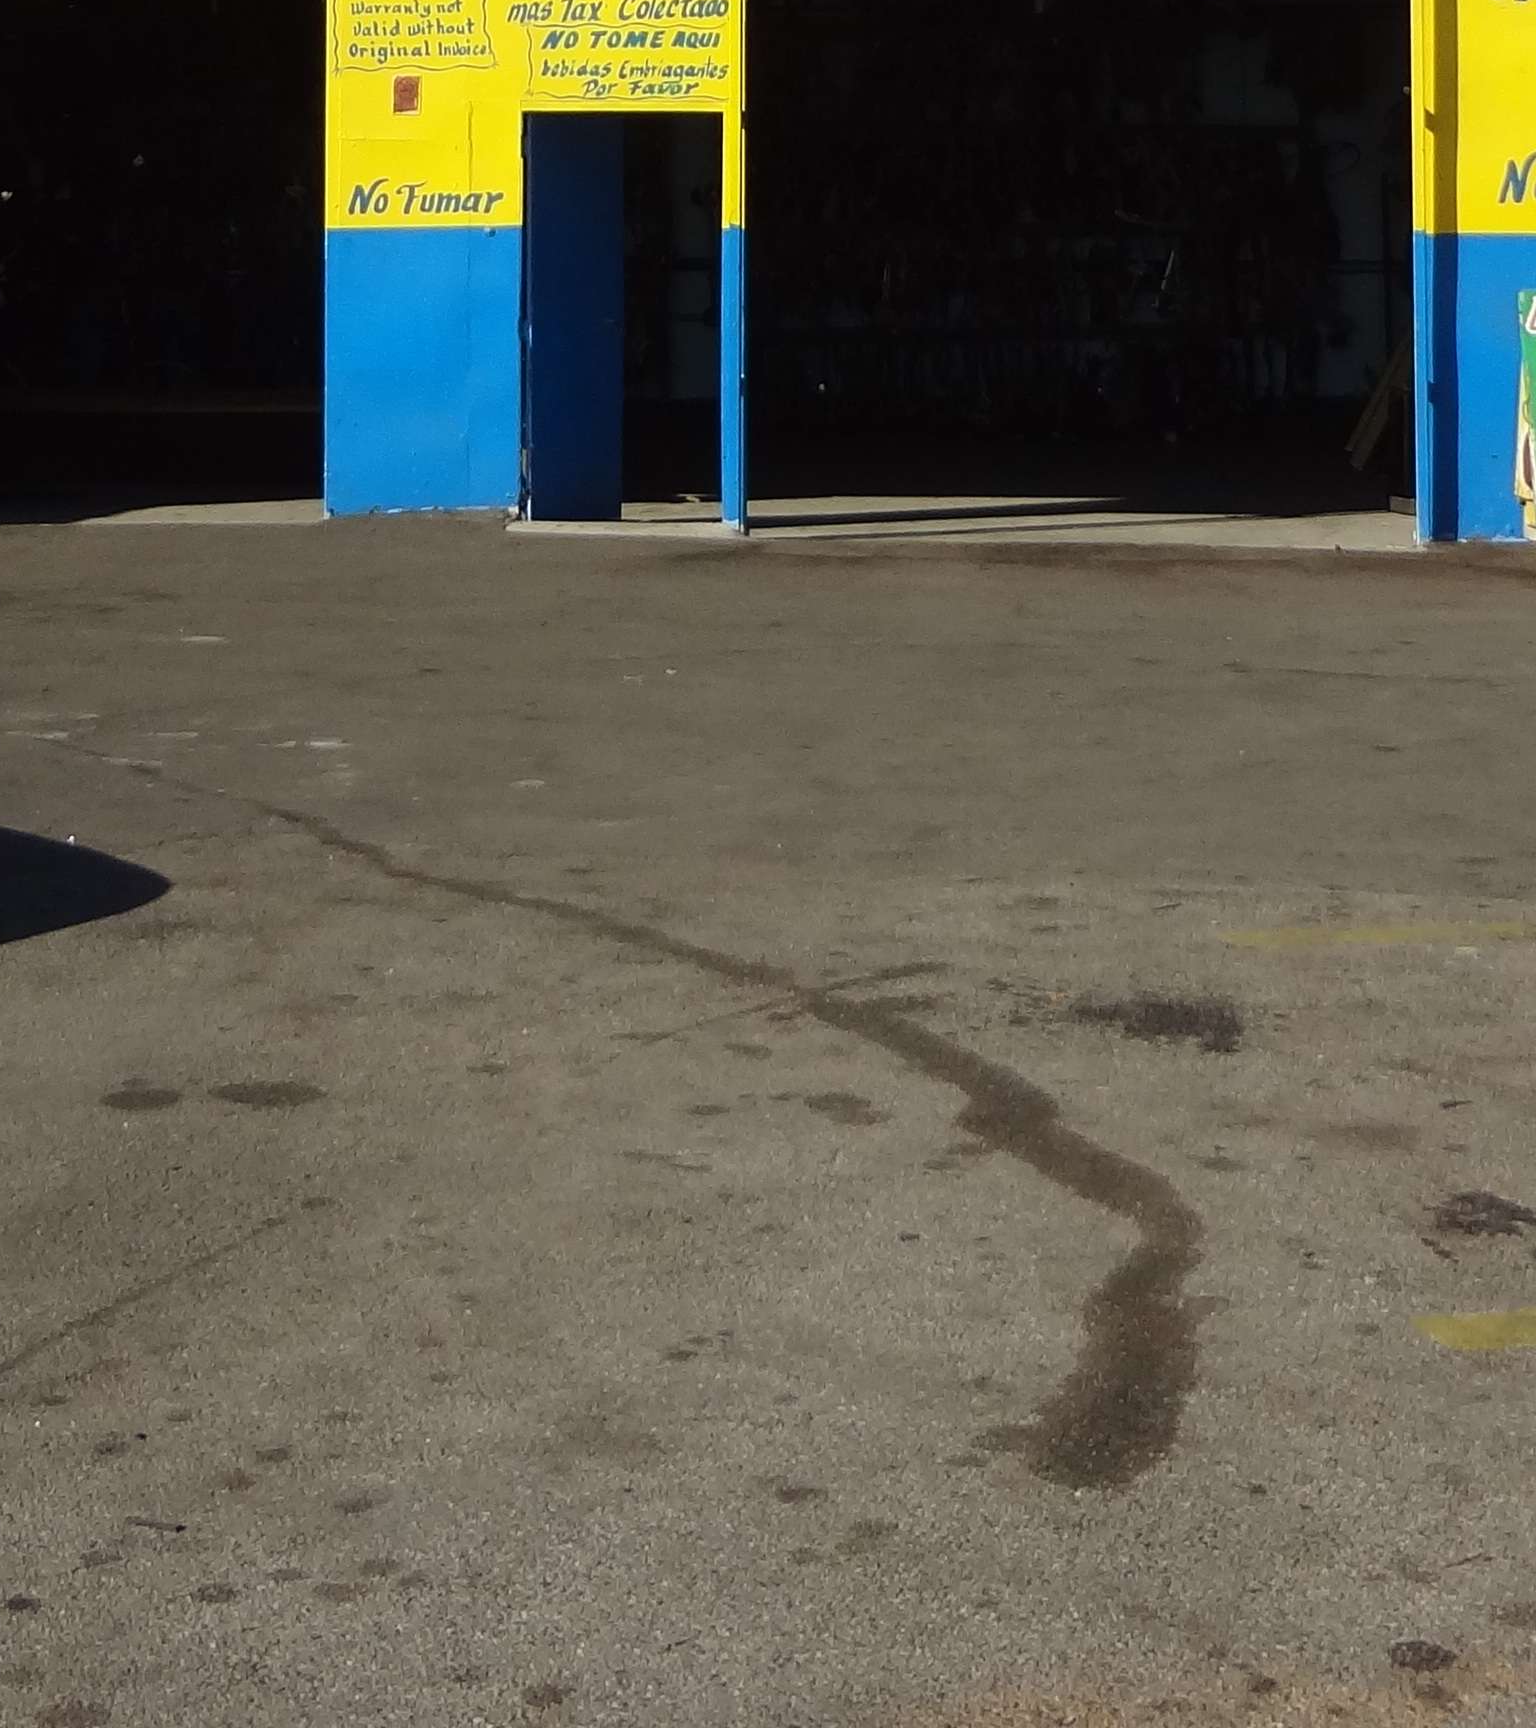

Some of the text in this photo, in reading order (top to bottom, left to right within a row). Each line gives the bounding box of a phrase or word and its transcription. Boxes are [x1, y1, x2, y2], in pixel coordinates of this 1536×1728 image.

[507, 0, 553, 23] mas
[408, 18, 475, 36] without
[541, 30, 721, 50] NO TOME AQUI
[349, 39, 431, 65] Original
[347, 177, 504, 216] No Fumar
